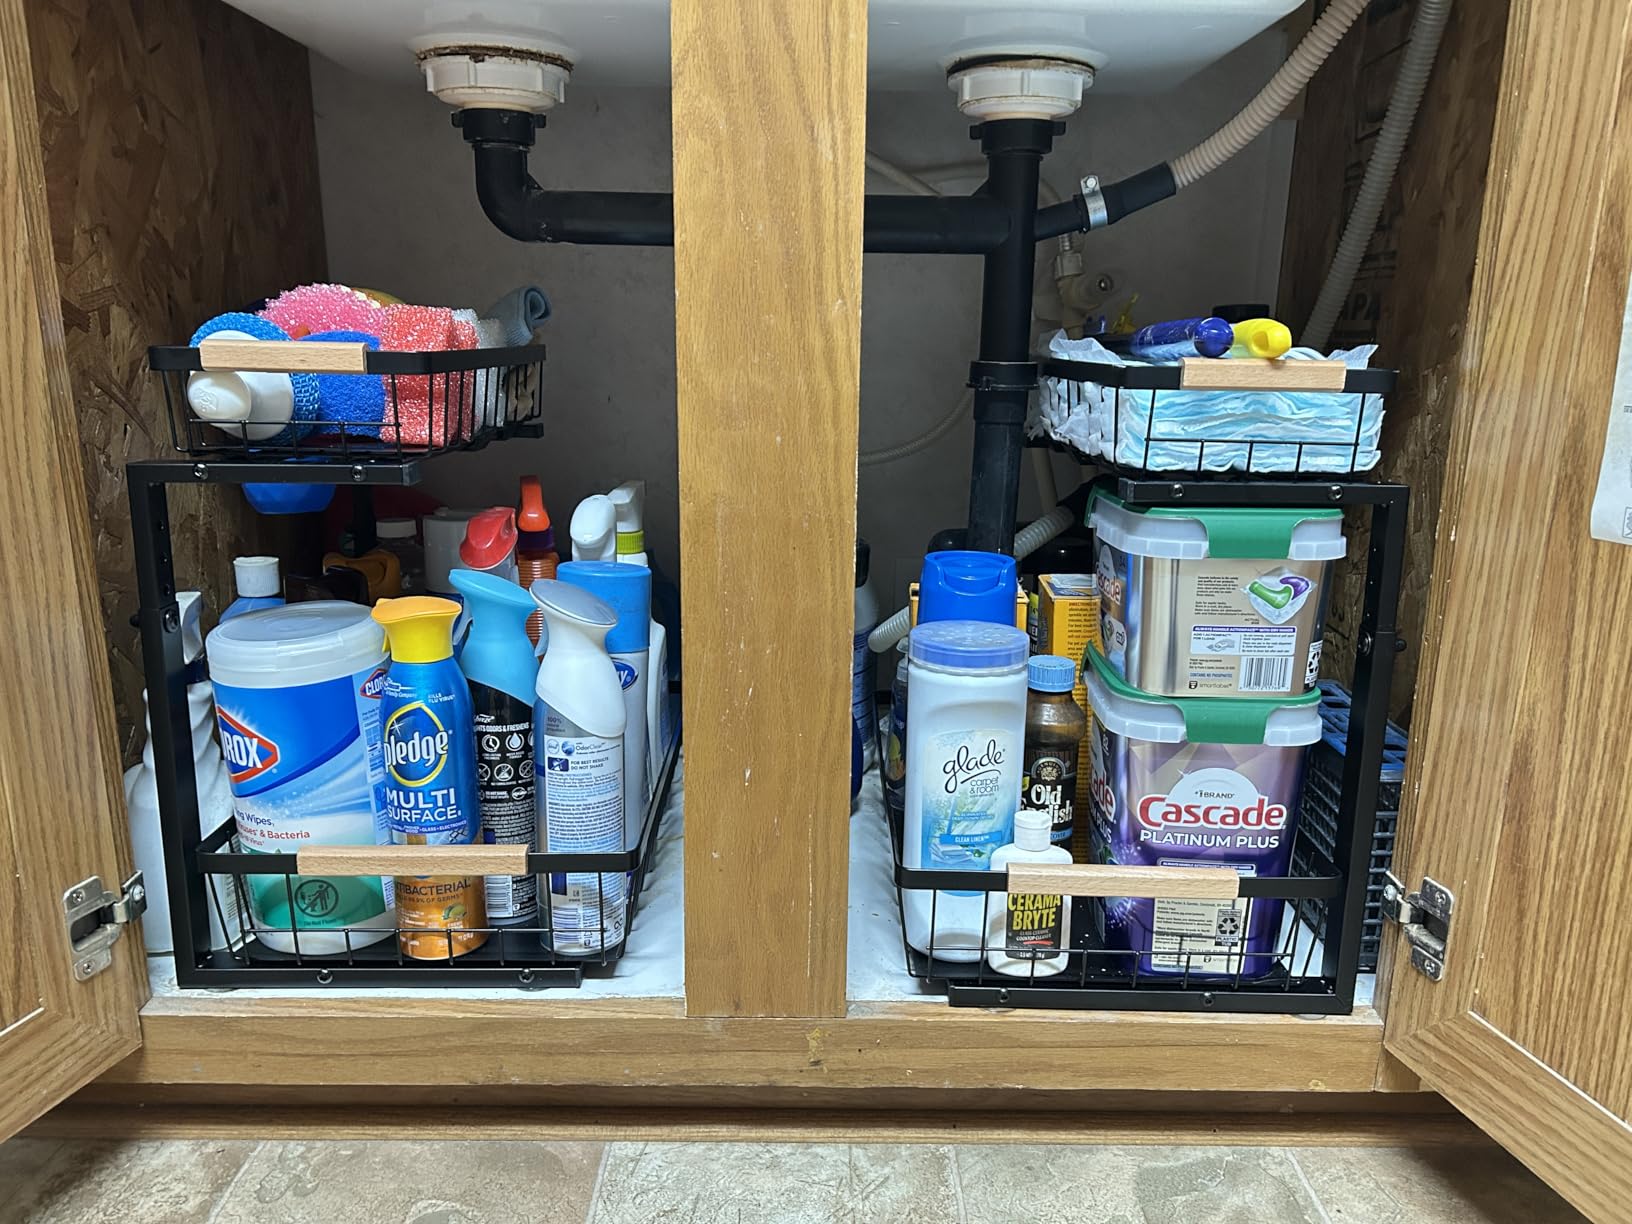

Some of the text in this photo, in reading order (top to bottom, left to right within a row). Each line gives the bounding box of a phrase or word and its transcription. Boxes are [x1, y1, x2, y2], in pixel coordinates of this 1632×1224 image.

[384, 731, 449, 774] pledge
[943, 739, 1005, 794] glade
[969, 776, 1000, 790] carpet
[969, 783, 1000, 795] & room
[1031, 783, 1063, 805] Old
[386, 787, 456, 809] MULTI
[1138, 796, 1285, 828] Cascade
[267, 830, 311, 840] Bacteria
[1140, 830, 1280, 849] PLATINUM PLUS
[1008, 893, 1061, 911] CERAMA
[1012, 907, 1056, 931] BRYTE
